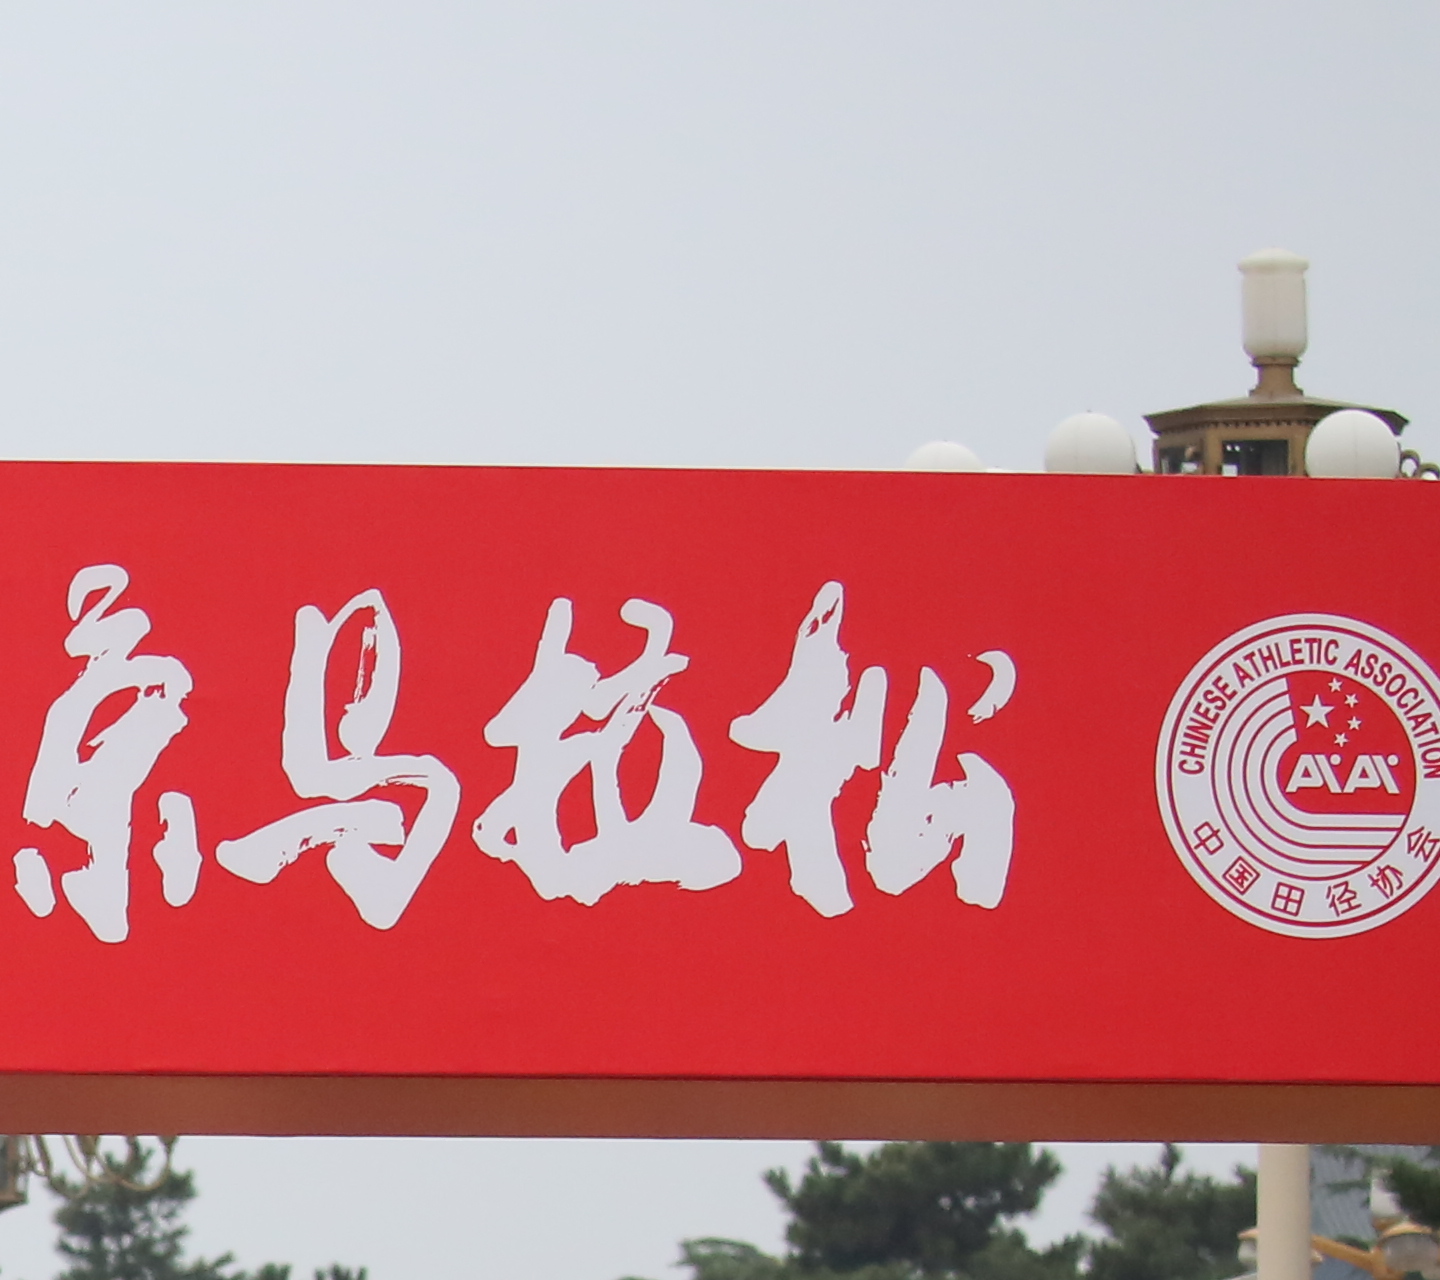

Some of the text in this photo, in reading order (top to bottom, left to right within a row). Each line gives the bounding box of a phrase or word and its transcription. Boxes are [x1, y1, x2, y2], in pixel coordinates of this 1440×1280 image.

[1177, 637, 1440, 779] CHINESE ATHLETIC ASSOCIATION
[1192, 820, 1440, 918] 中国田径协会
